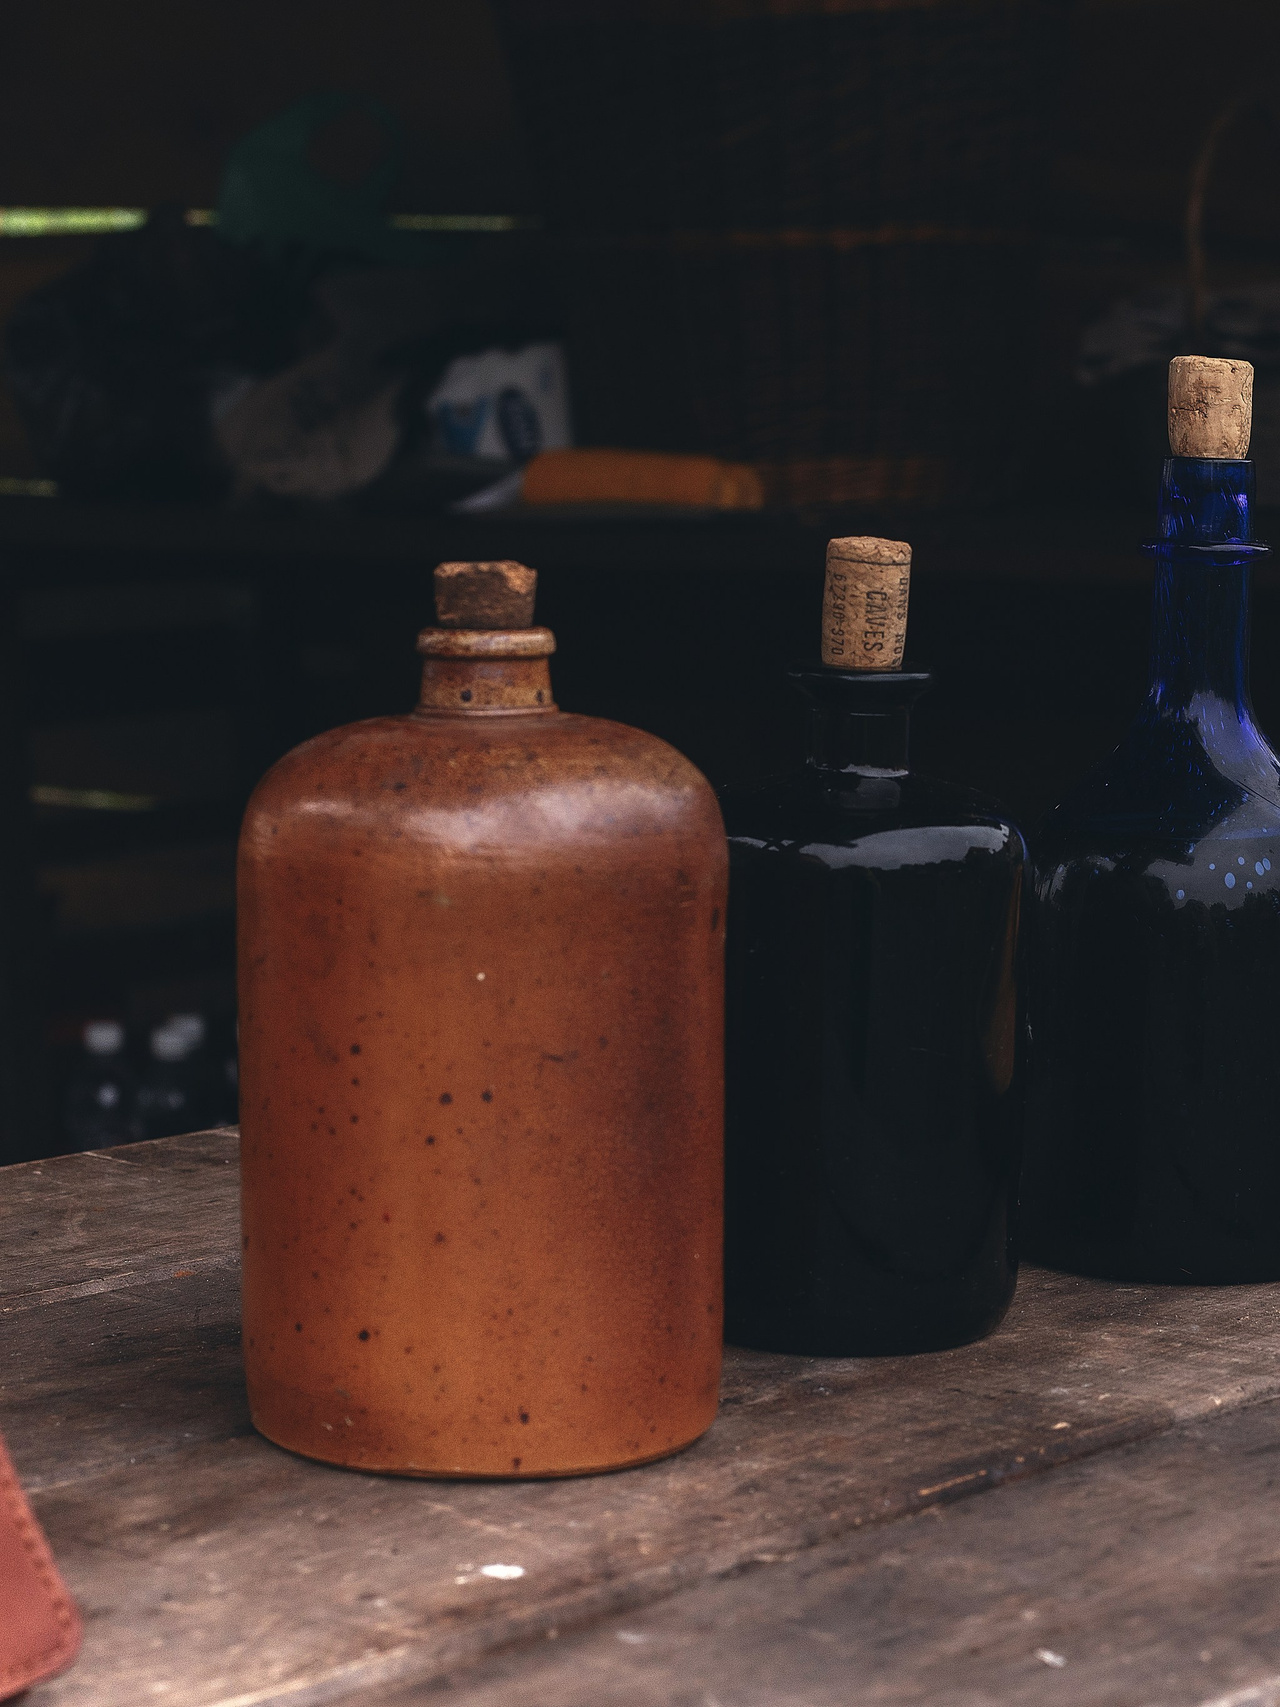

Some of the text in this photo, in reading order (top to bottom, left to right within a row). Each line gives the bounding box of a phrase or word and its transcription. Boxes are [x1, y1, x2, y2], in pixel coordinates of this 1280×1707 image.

[863, 590, 888, 653] CAVES
[890, 577, 909, 667] DANS NOS
